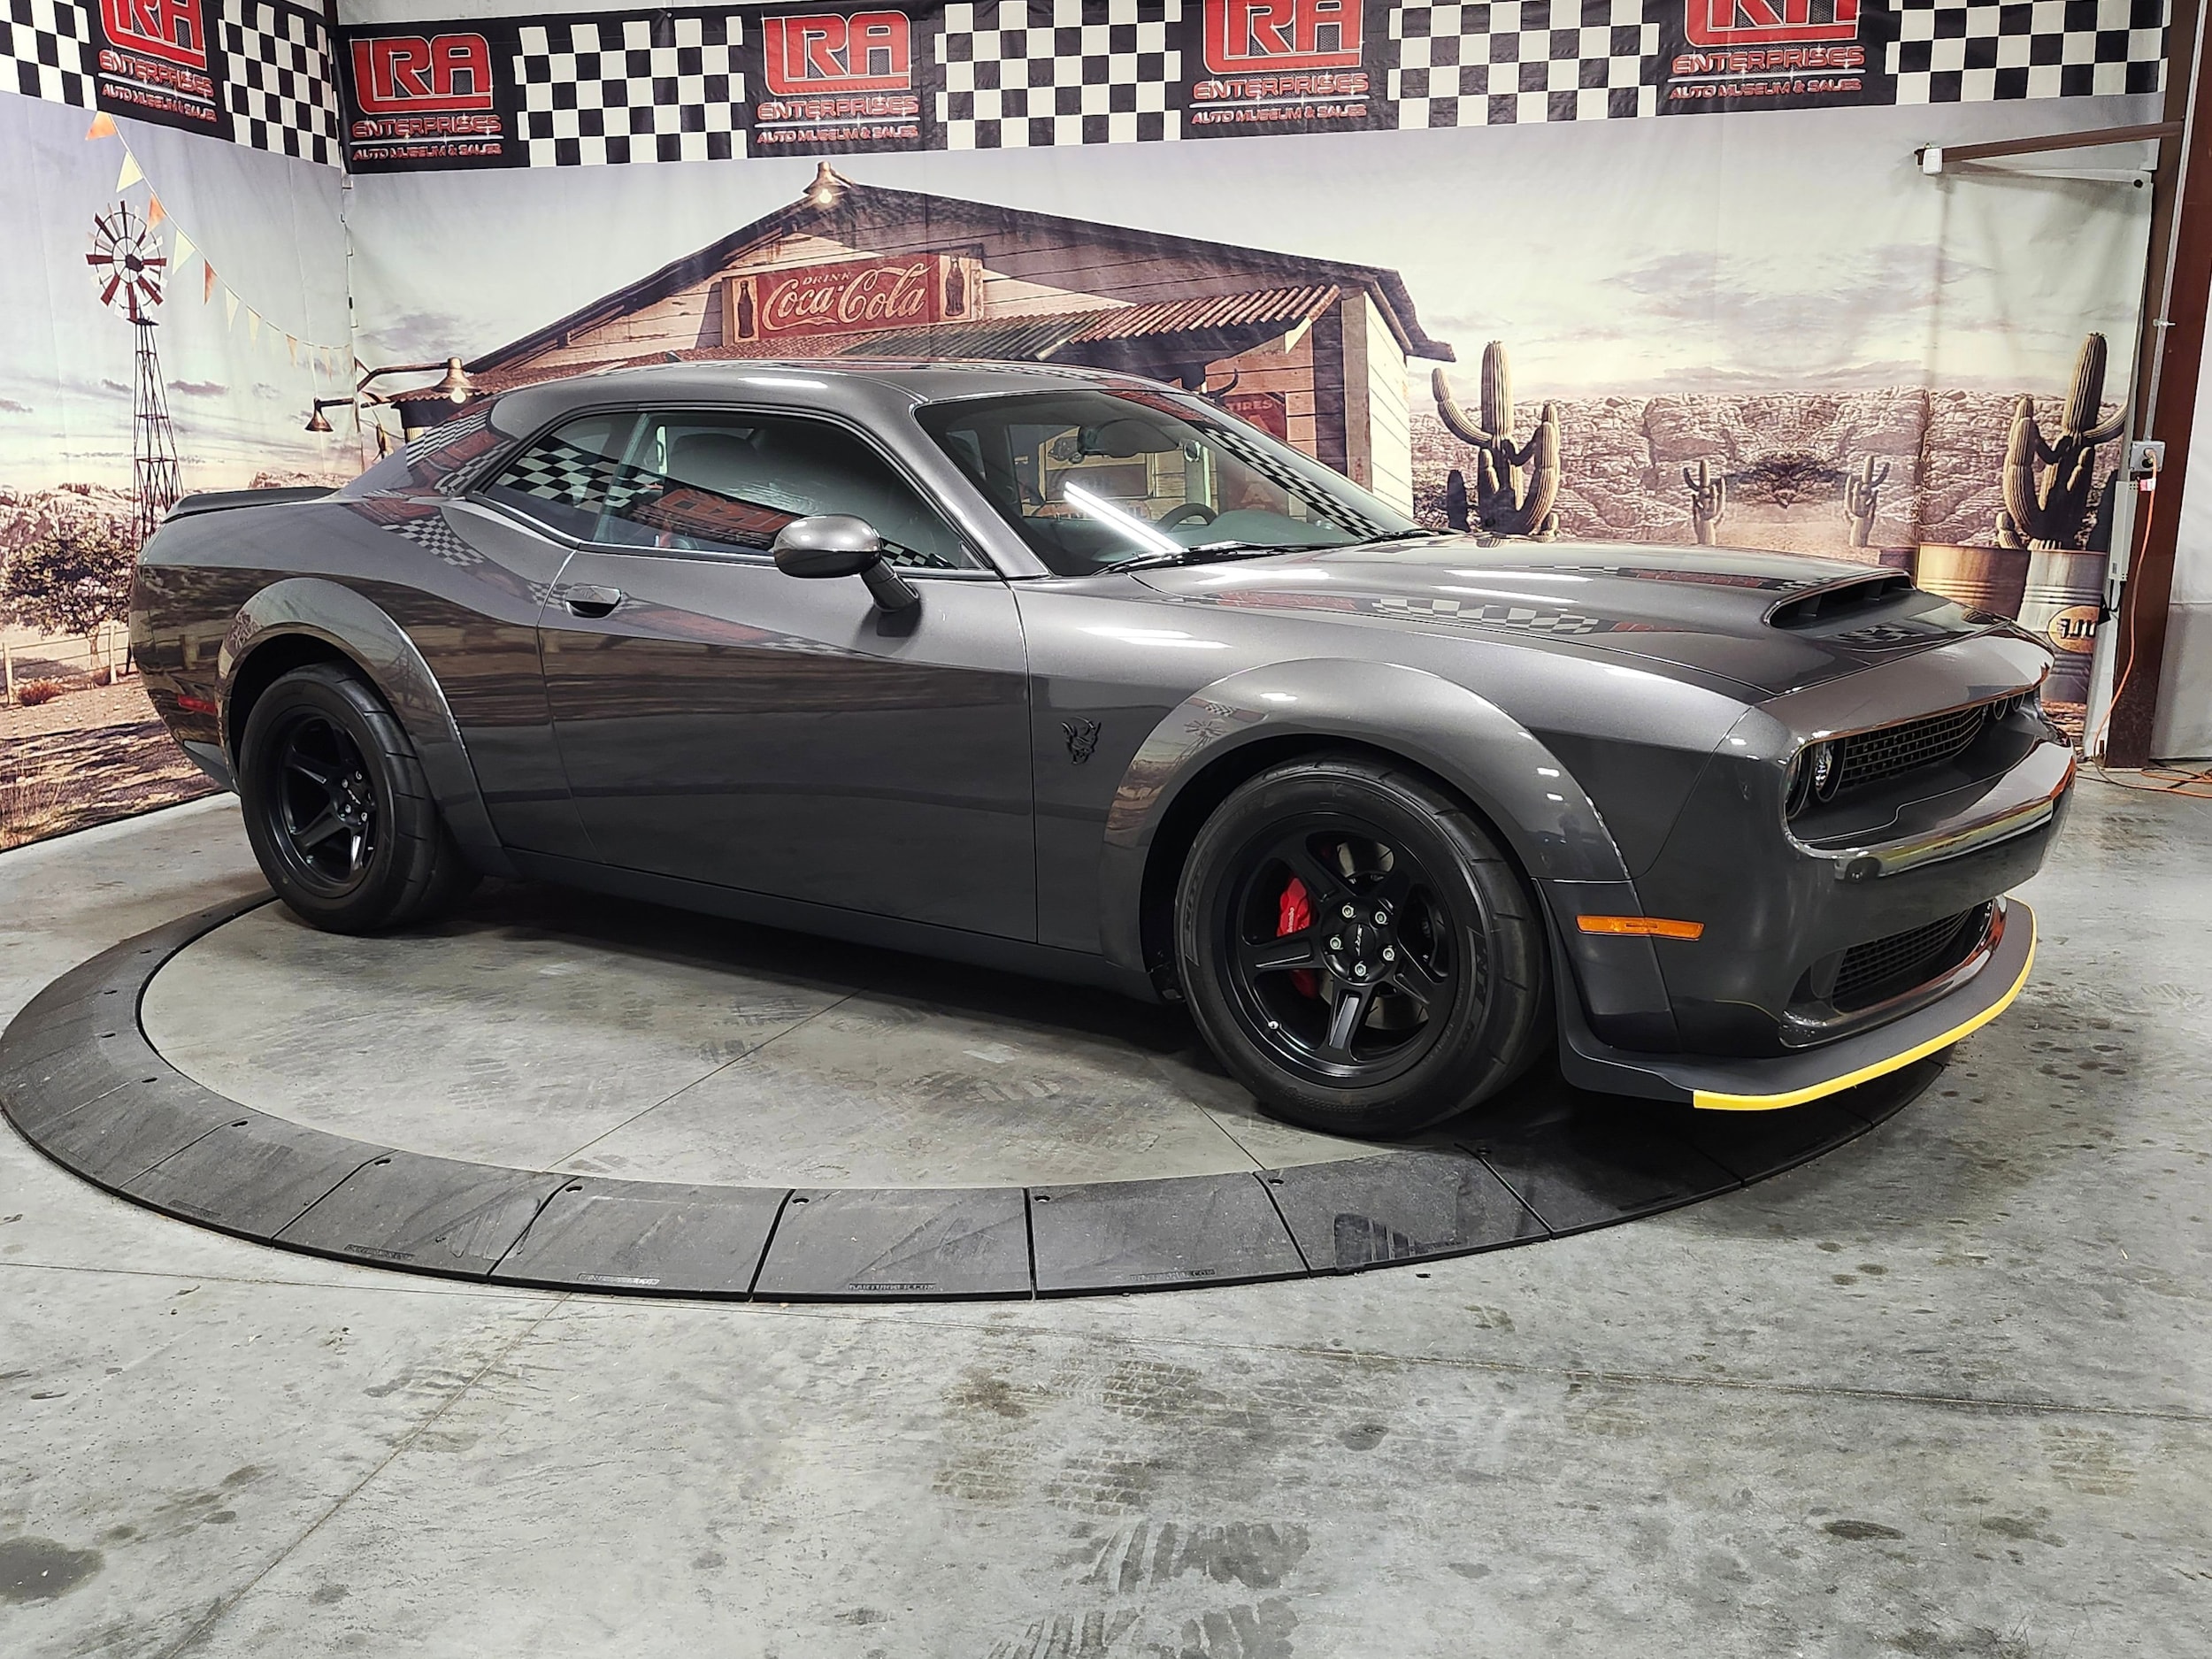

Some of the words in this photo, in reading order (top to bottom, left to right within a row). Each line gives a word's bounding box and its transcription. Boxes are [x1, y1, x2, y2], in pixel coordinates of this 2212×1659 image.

[1203, 0, 1363, 74] LRA
[761, 10, 911, 96] LRA
[1671, 46, 1865, 74] ENTERPRISES
[99, 49, 215, 97] ENTERPRISES
[349, 33, 494, 114] LRA
[1192, 73, 1369, 100] ENTERPRISES
[1669, 85, 1717, 100] AUTO
[1718, 81, 1791, 97] MUSEUM
[1793, 80, 1805, 94] &
[1808, 78, 1862, 92] SALES
[757, 96, 919, 120] ENTERPRISES
[1191, 109, 1234, 125] AUTO
[1235, 106, 1303, 122] MUSEUM
[1304, 105, 1316, 119] &
[1317, 104, 1367, 118] SALES
[351, 115, 502, 138] ENTERPRISES
[757, 131, 795, 144] AUTO
[797, 127, 859, 142] MUSEUM
[860, 127, 871, 140] &
[872, 125, 918, 140] SALES
[353, 148, 388, 160] AUTO
[458, 142, 502, 156] SALES
[802, 272, 851, 286] DRINK
[1225, 399, 1273, 413] TIRES
